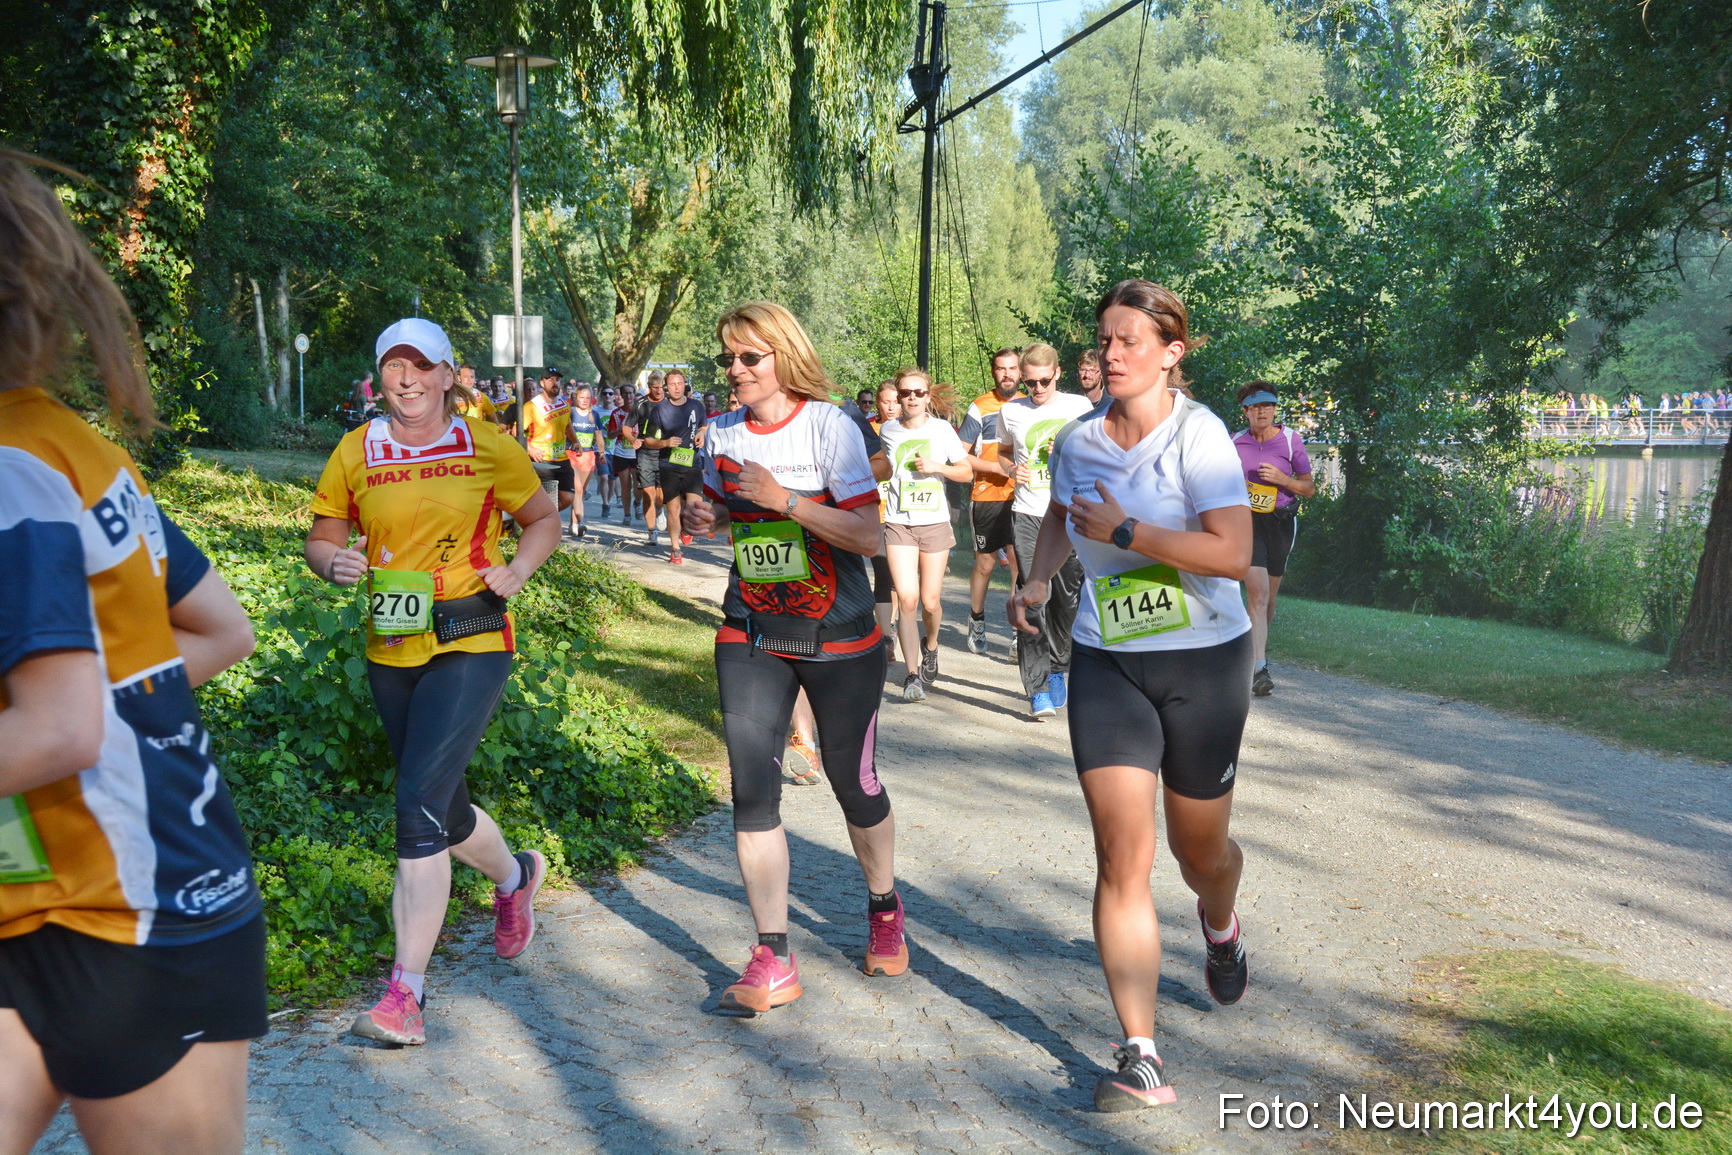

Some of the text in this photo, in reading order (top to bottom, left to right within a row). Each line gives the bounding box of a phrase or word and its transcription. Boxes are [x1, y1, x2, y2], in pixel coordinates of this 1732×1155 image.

[673, 452, 692, 462] 1597
[366, 462, 476, 488] MAX BÖGL
[770, 464, 813, 473] NEUMARKT
[910, 491, 932, 503] 147
[742, 542, 793, 566] 1907
[372, 592, 420, 618] 270
[1108, 587, 1173, 623] 1144
[1120, 615, 1164, 630] Söllner Karin
